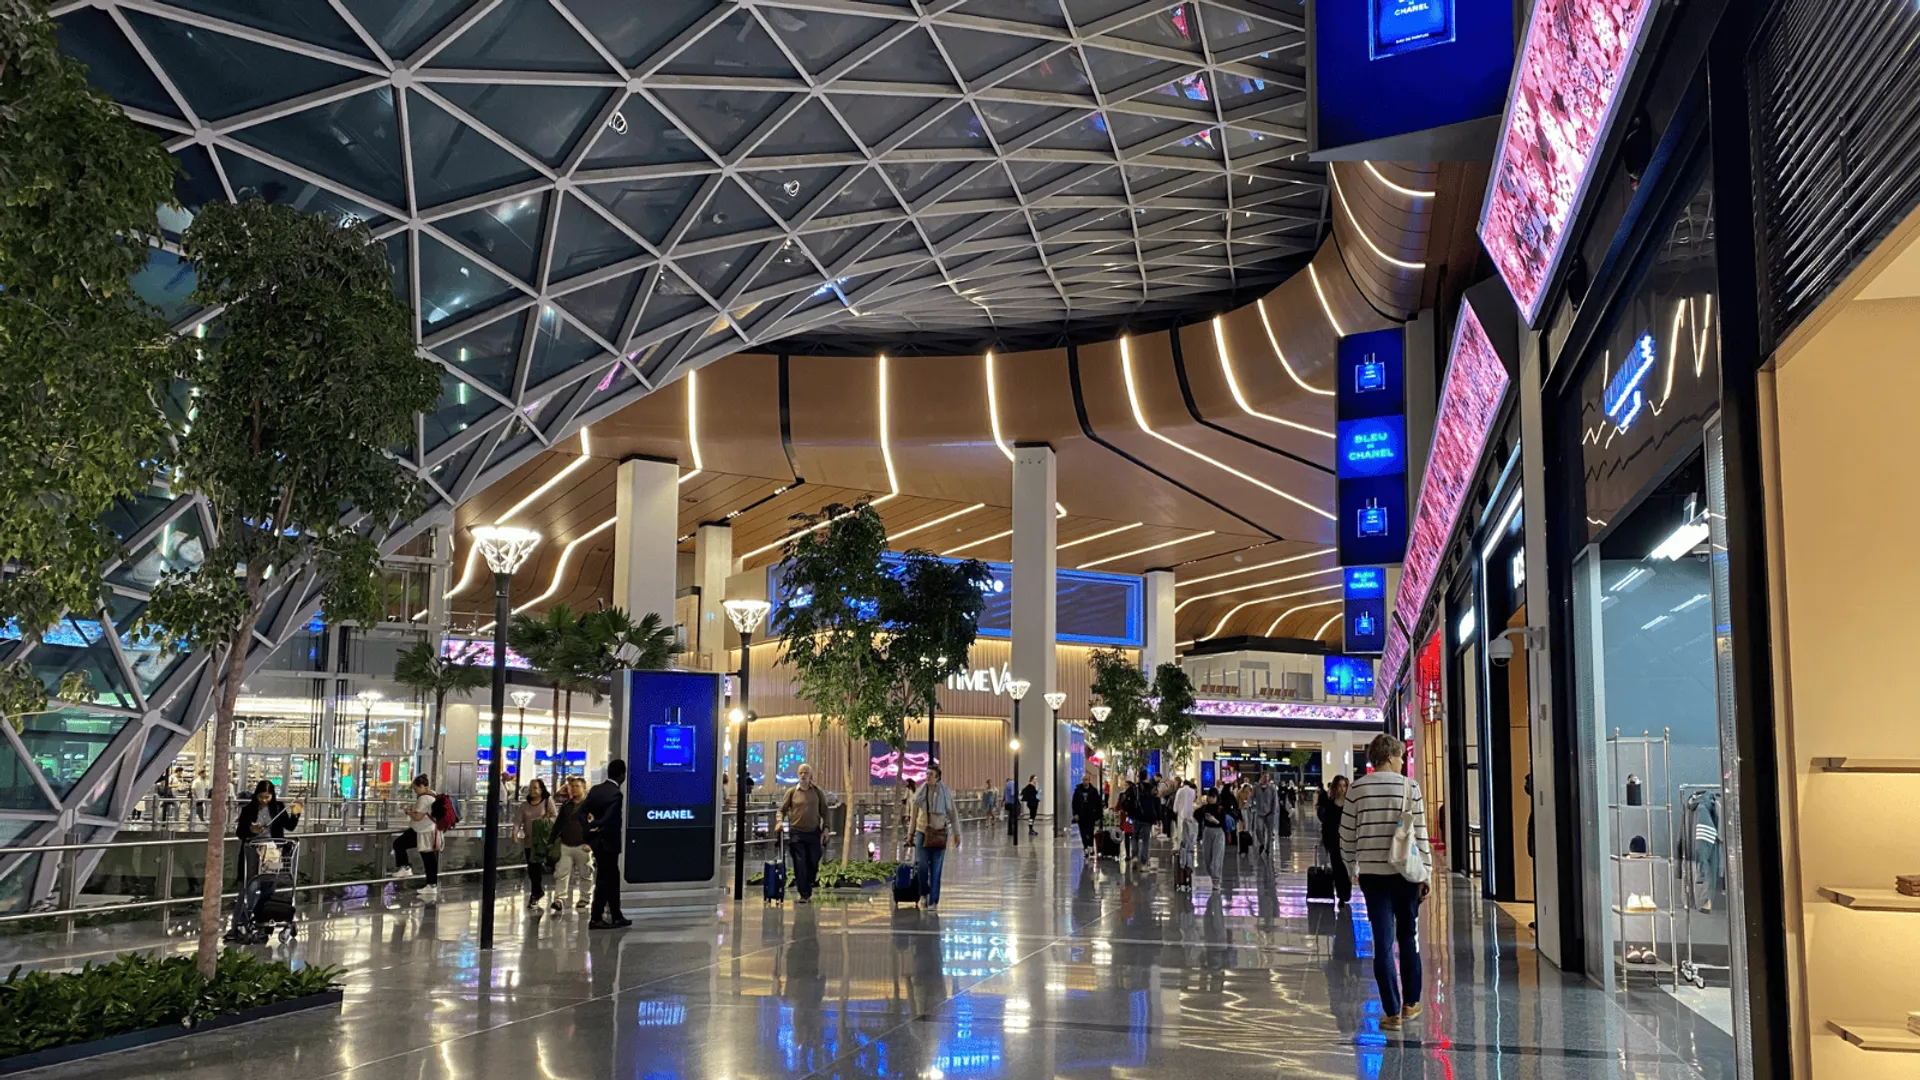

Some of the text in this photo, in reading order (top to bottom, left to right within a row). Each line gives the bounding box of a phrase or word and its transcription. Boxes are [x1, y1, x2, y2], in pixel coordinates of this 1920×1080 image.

[1394, 3, 1429, 16] CHANEL
[1354, 432, 1388, 444] BLEU
[1348, 448, 1394, 461] CHANEL
[647, 810, 694, 819] CHANEL
